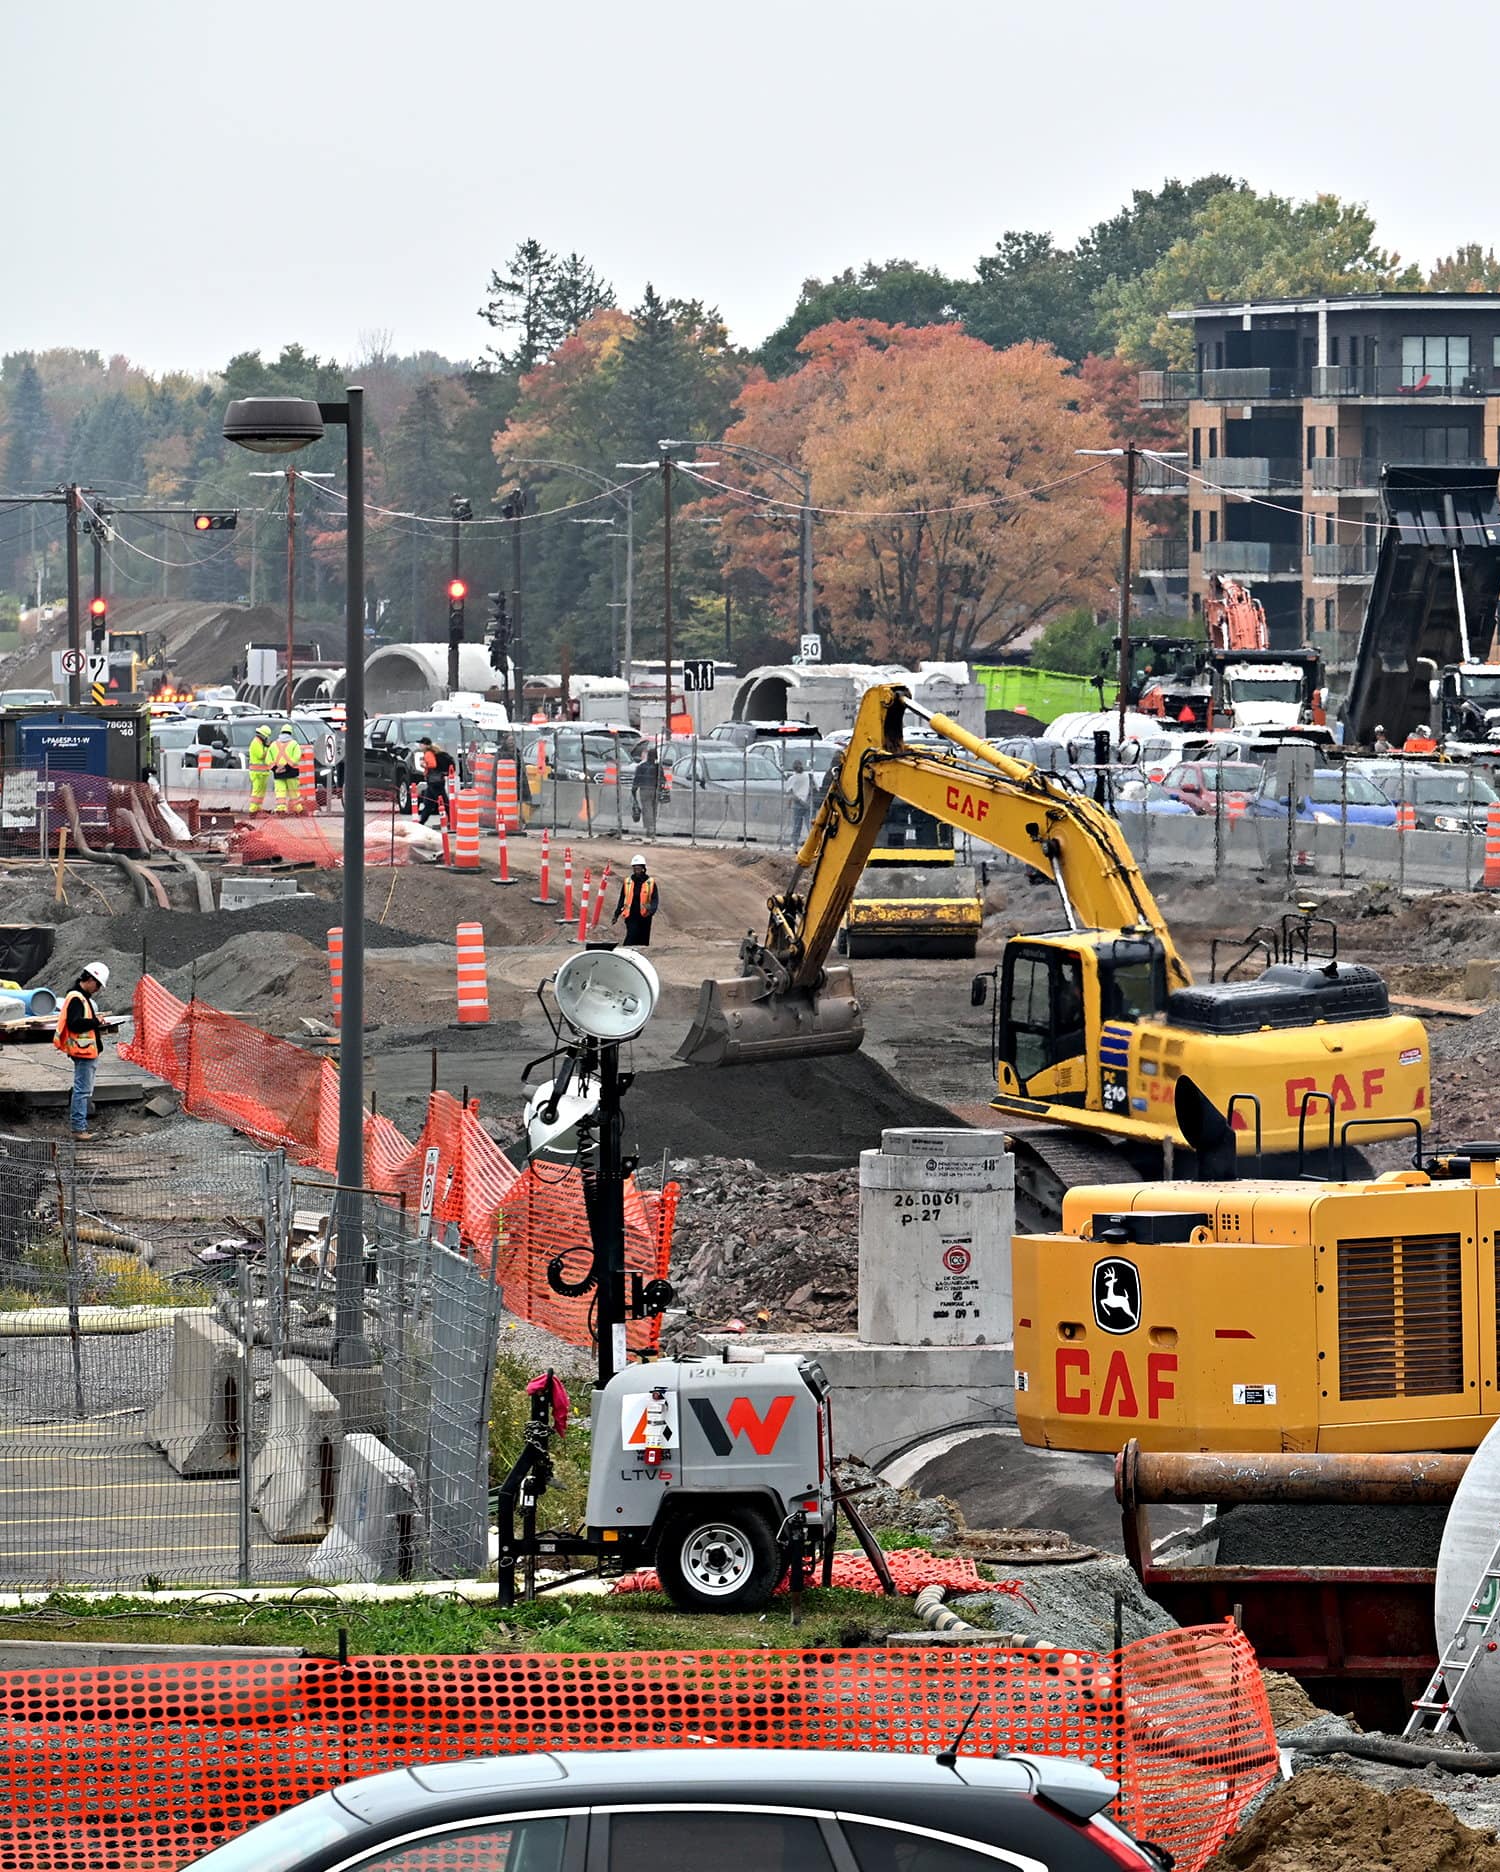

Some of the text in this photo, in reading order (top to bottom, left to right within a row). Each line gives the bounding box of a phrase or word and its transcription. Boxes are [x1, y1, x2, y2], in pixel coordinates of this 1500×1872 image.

[803, 642, 819, 656] 50
[946, 785, 990, 822] CAF
[1103, 1084, 1127, 1102] 210
[1285, 1067, 1385, 1117] CAF
[1055, 1348, 1178, 1419] CAF
[621, 1469, 673, 1481] LTV6
